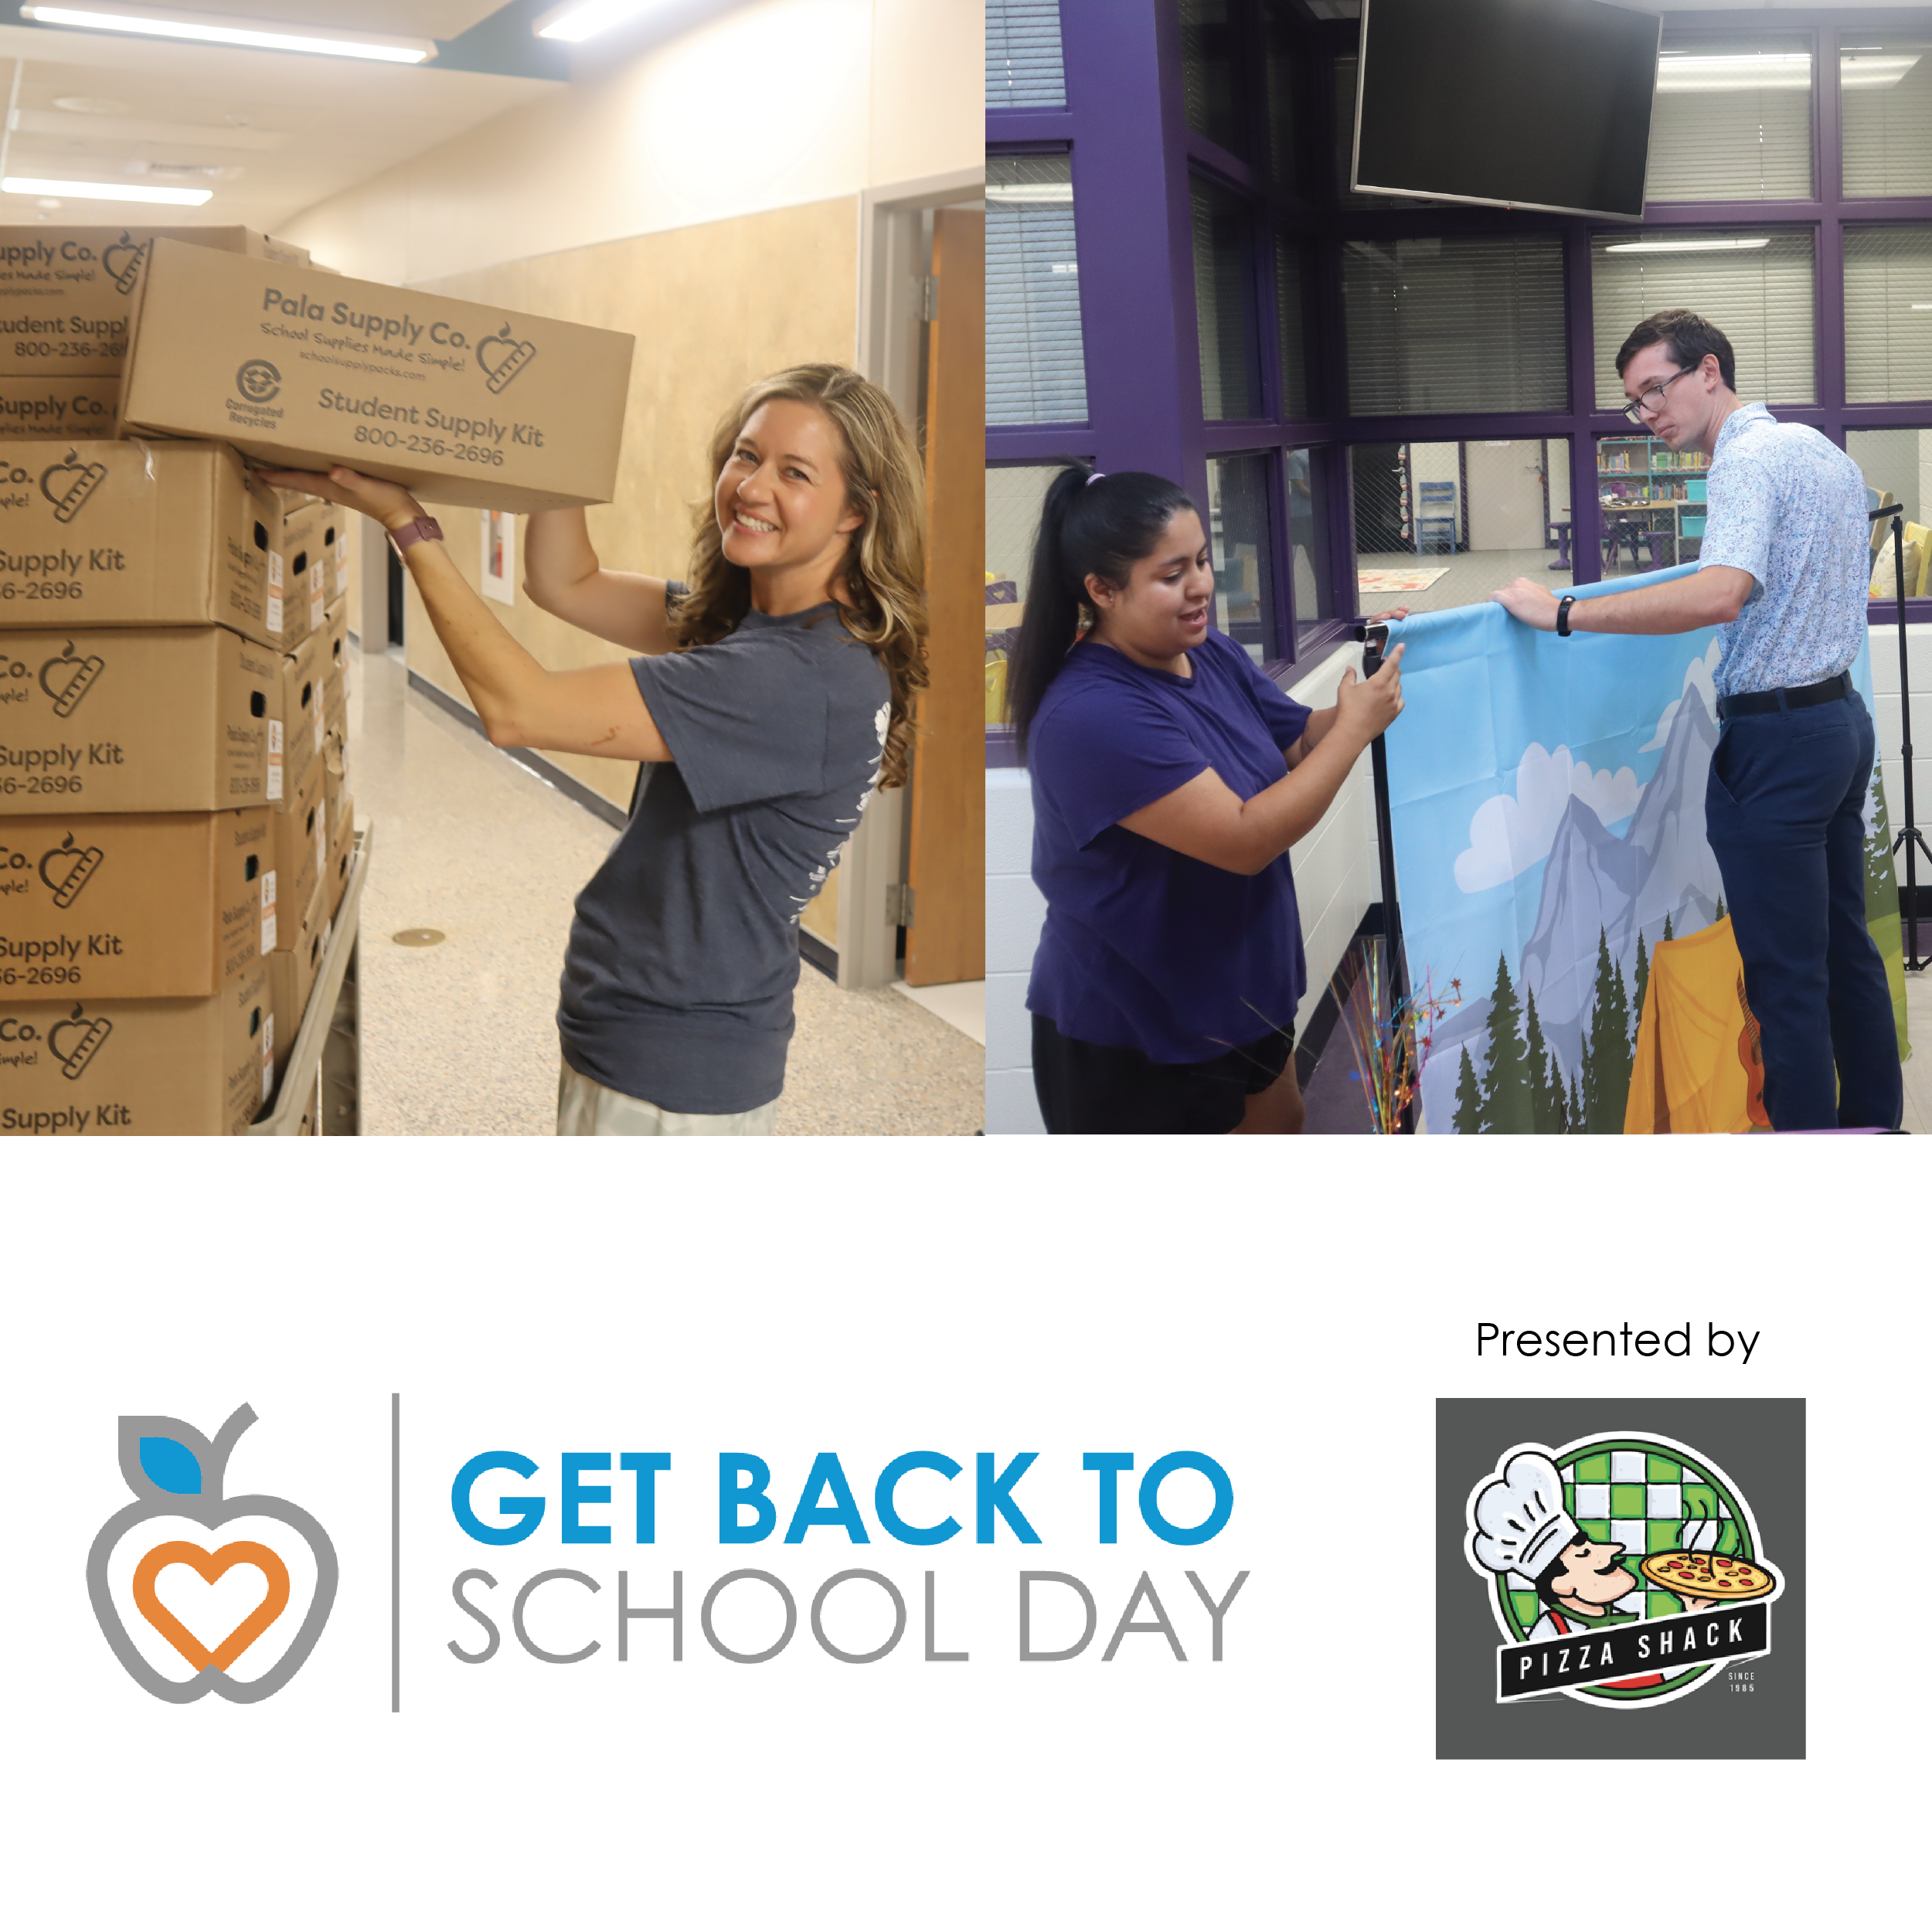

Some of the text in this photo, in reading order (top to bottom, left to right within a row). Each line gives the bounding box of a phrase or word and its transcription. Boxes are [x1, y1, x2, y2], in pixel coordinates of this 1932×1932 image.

[60, 240, 97, 261] Co.
[263, 287, 471, 350] Pala Supply Co.
[260, 321, 466, 372] School Supplies Made Simple!
[298, 350, 427, 381] schoolsupplypacks.com
[72, 395, 109, 415] Co.
[225, 397, 284, 419] Corrugated
[228, 410, 277, 430] Recycles
[318, 387, 545, 448] Student Supply Kit
[353, 424, 505, 467] 800-236-2696
[0, 492, 29, 510] ple!
[89, 547, 126, 570] Kit
[0, 580, 83, 600] 6-2696
[88, 741, 124, 764] Kit
[0, 775, 83, 794] 6-2696
[0, 878, 29, 896] ple!
[88, 933, 124, 956] Kit
[0, 965, 81, 985] 6-2696
[0, 1018, 42, 1042] Co.
[2, 1103, 132, 1134] Supply Kit
